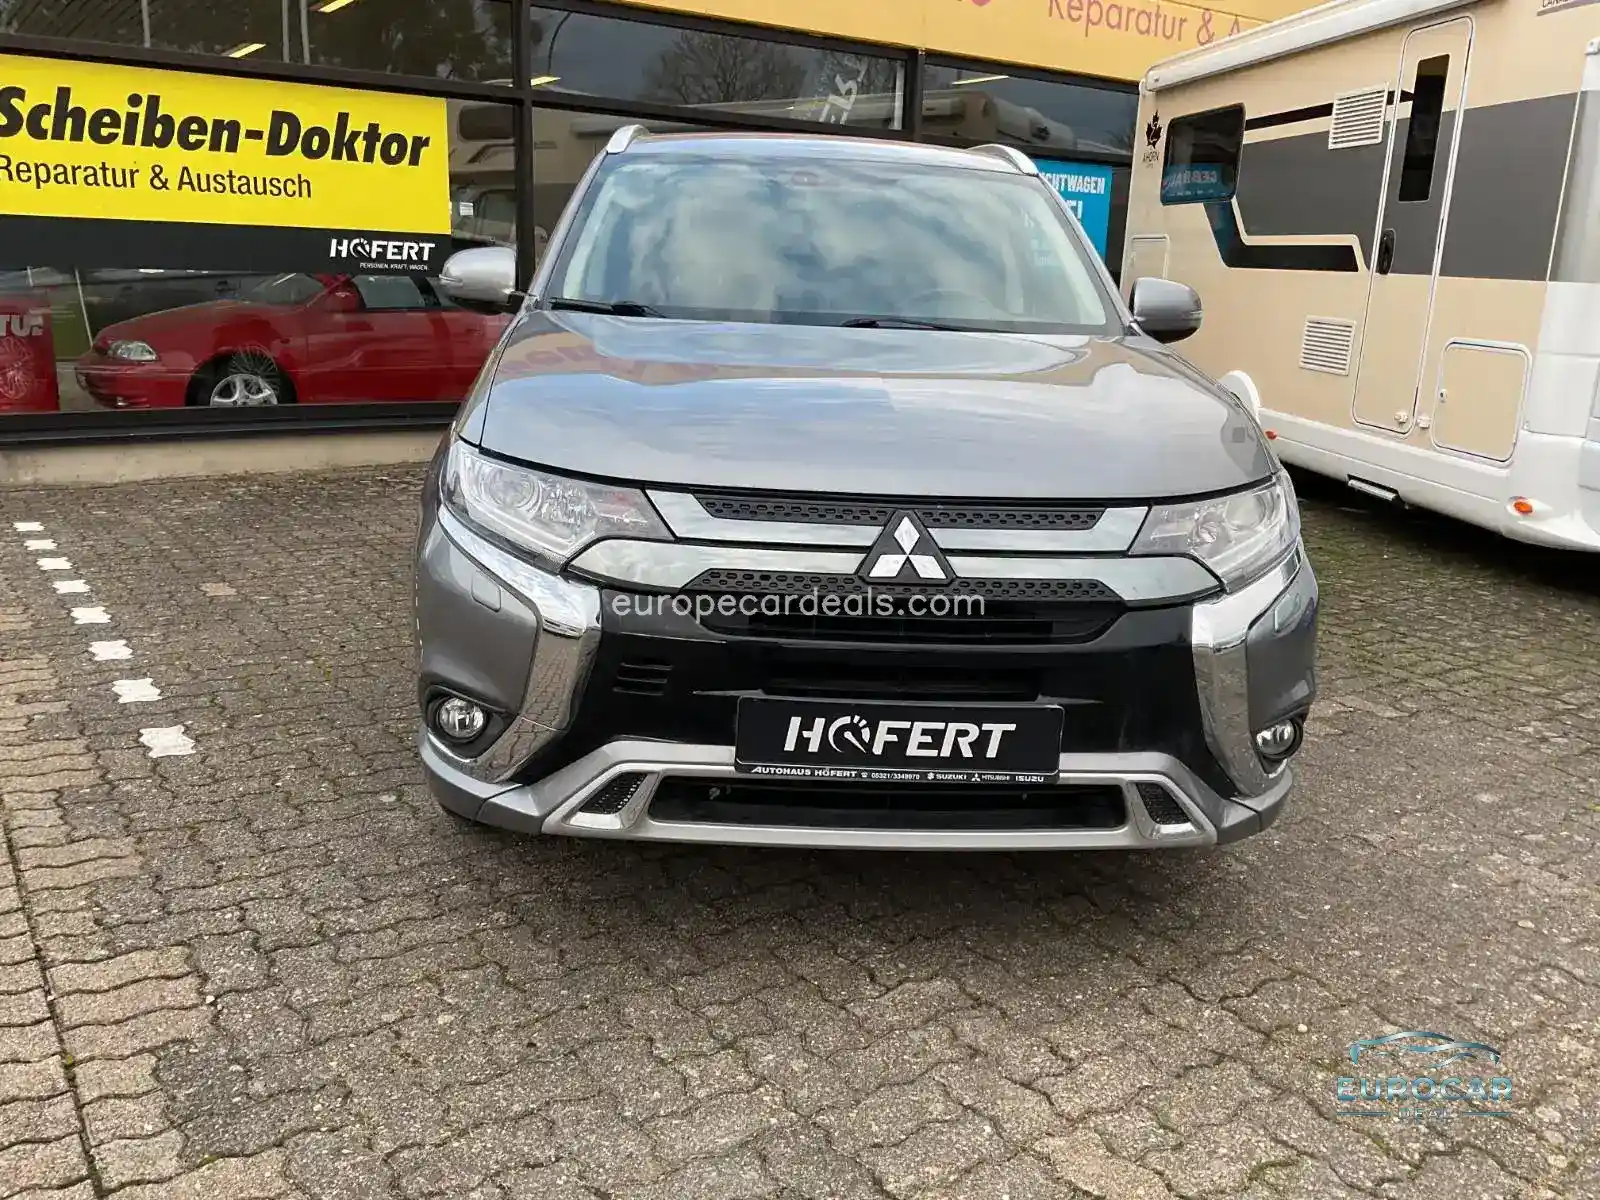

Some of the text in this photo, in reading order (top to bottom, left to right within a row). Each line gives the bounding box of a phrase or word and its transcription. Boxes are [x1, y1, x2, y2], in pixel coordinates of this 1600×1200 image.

[1196, 9, 1216, 46] &
[0, 85, 430, 168] Scheiben-Doktor
[0, 153, 312, 198] Reparatur & Austausch
[751, 766, 812, 776] AUTOHAUS
[935, 773, 967, 781] SUZUKI
[1015, 775, 1045, 783] ISUZU
